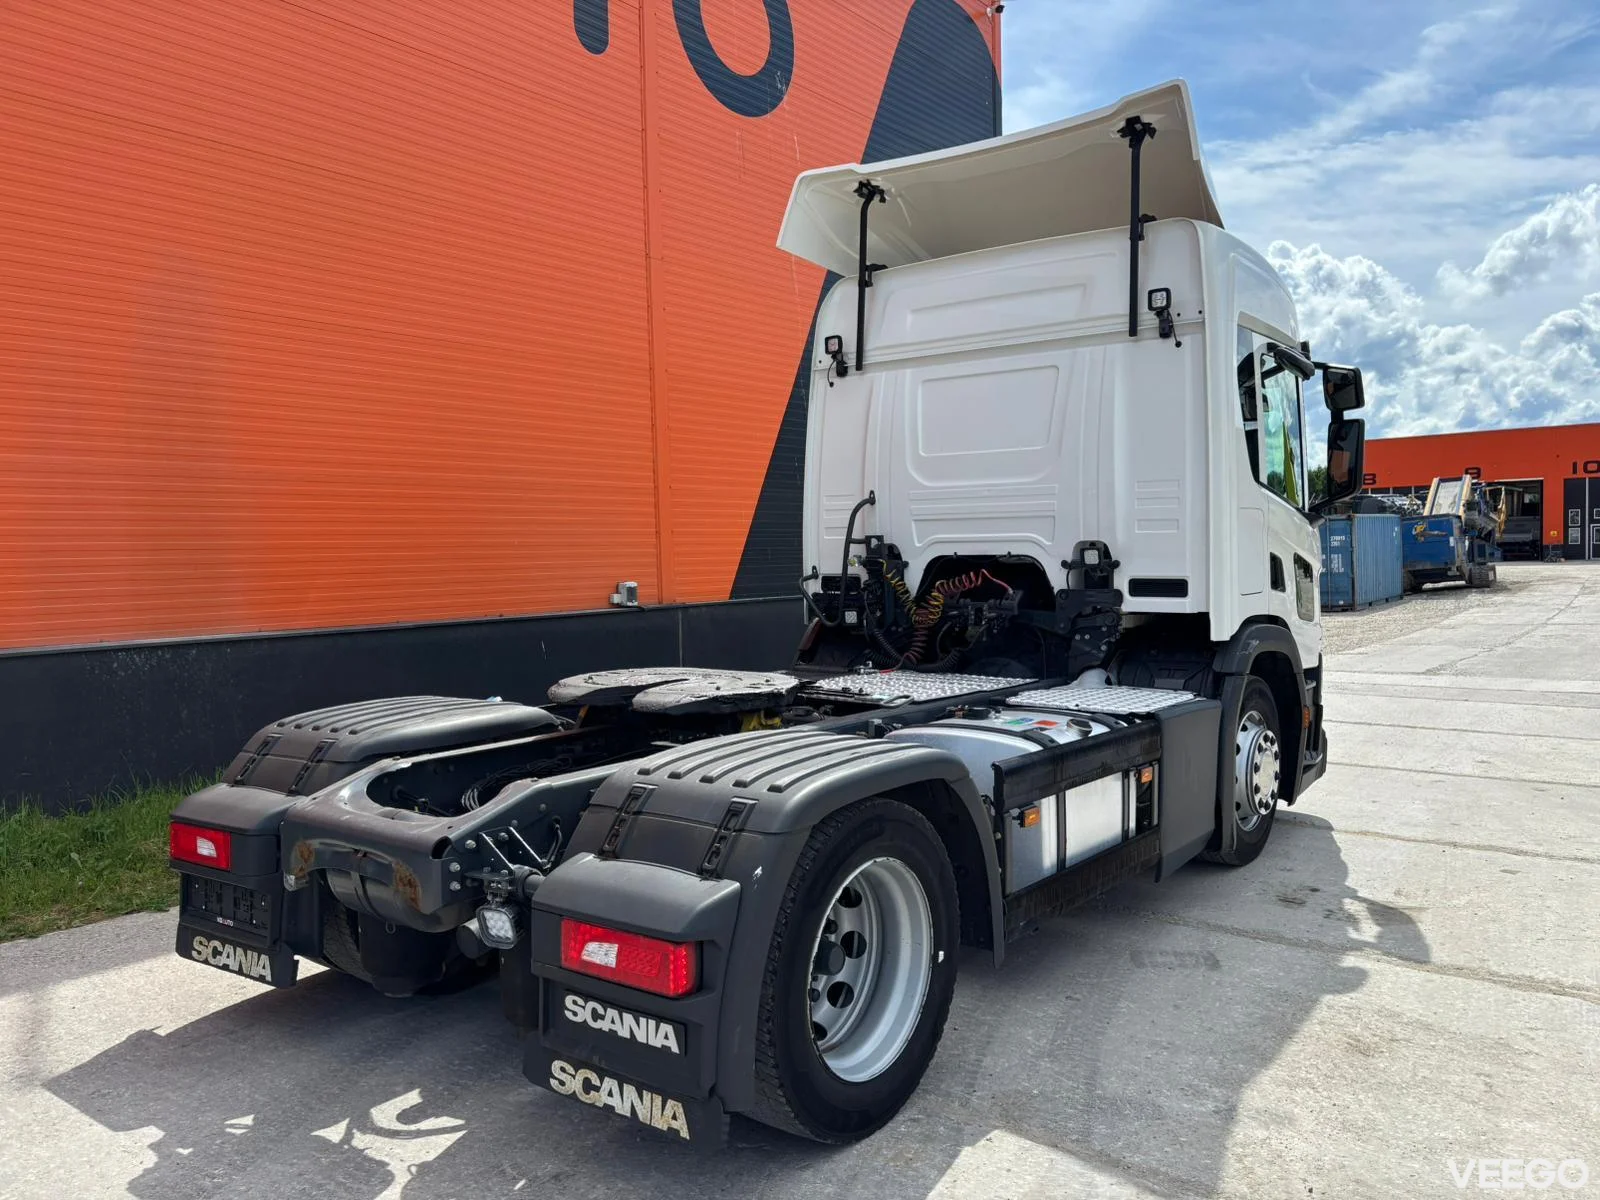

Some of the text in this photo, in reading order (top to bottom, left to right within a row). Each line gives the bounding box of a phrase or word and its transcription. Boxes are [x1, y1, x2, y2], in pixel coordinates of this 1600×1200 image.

[191, 936, 272, 982] SCANIA
[564, 994, 680, 1054] SCANIA
[550, 1059, 690, 1141] SCANIA
